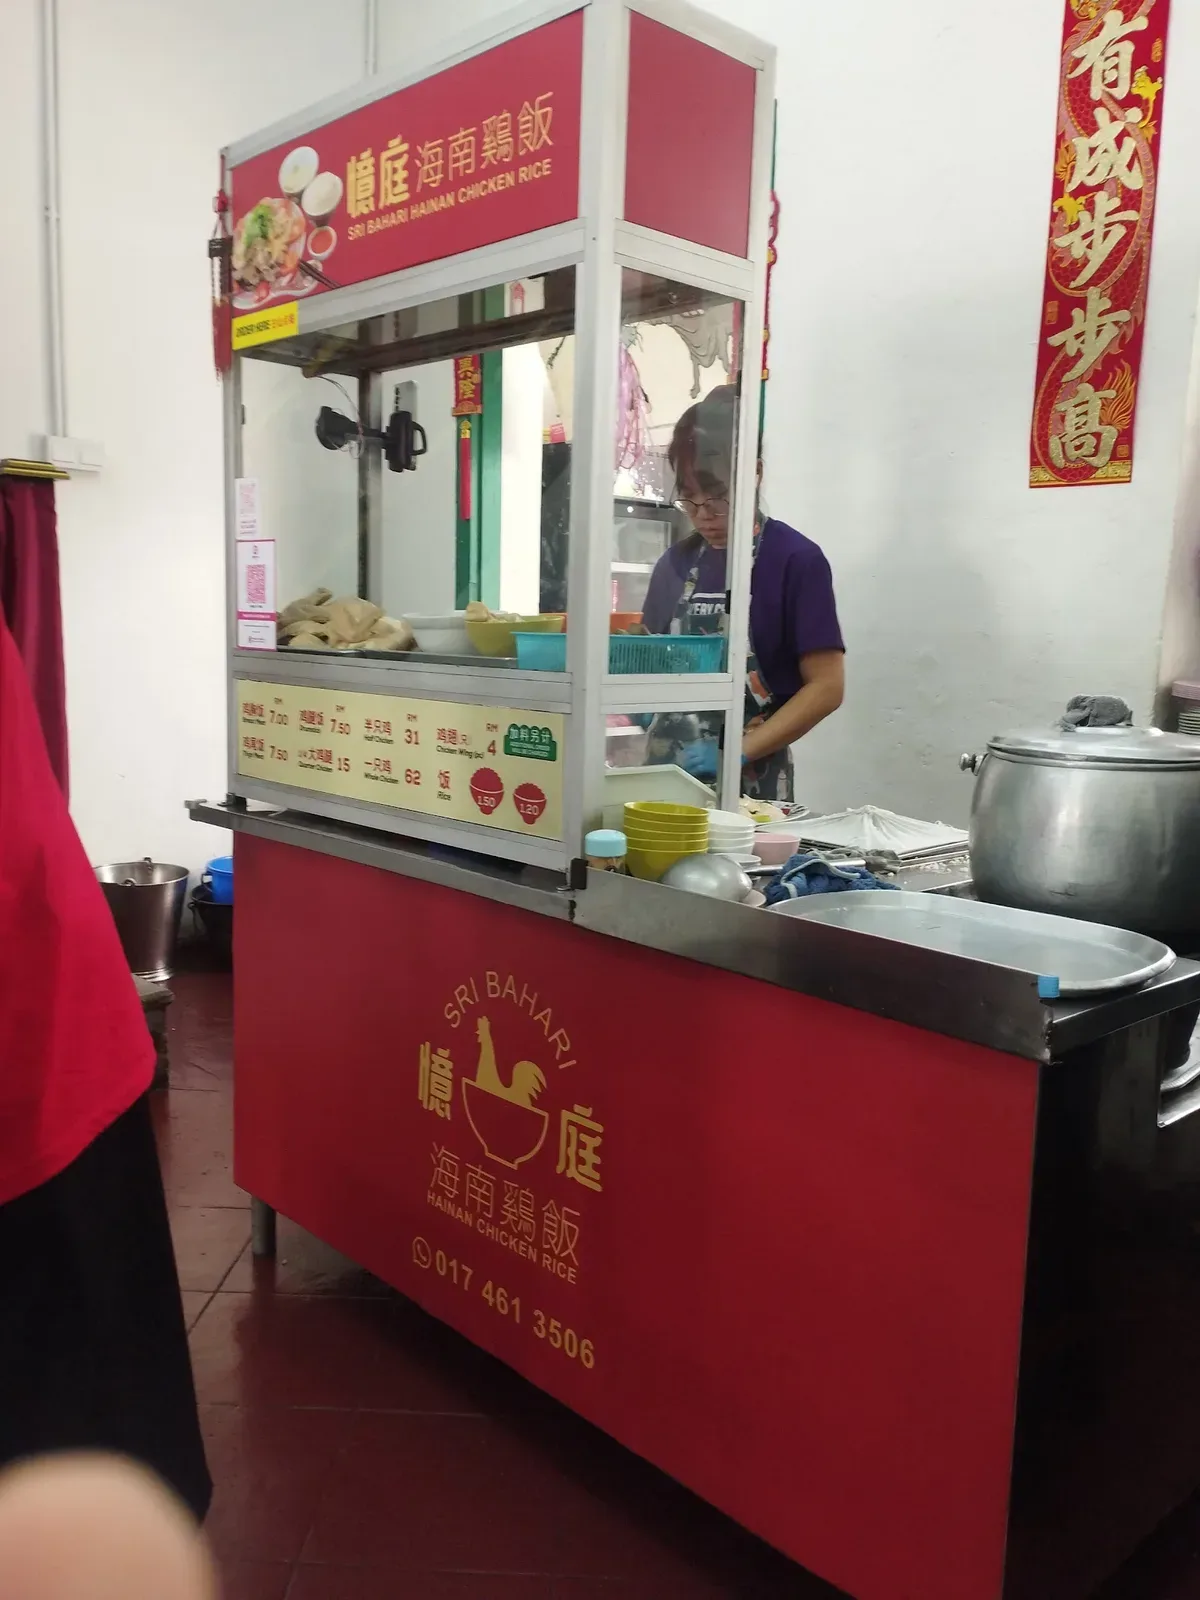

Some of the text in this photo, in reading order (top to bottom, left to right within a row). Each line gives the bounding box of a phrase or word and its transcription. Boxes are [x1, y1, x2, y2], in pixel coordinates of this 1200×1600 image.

[347, 158, 553, 241] SRI BAHARI HAINAN CHICKEN RICE
[1048, 8, 1149, 469] 有成步步高
[269, 709, 289, 726] 7.00
[406, 713, 418, 722] RM
[330, 718, 351, 735] 7.50
[364, 718, 392, 736] 半只鸡
[486, 723, 498, 732] RM
[404, 728, 420, 745] 31
[269, 745, 289, 761] 7.50
[436, 744, 458, 755] Chicken
[458, 747, 473, 759] Wing
[487, 739, 497, 756] 4
[337, 757, 350, 773] 15
[364, 757, 392, 775] 一只鸡
[379, 774, 399, 784] Chicken
[404, 768, 421, 786] 62
[437, 769, 451, 790] 饭
[437, 791, 452, 801] Rice
[444, 970, 578, 1070] SRI BAHARI
[556, 1103, 605, 1192] 庭
[427, 1189, 577, 1285] HAINAN CHICKEN RICE
[435, 1250, 595, 1369] 017 461 3506
